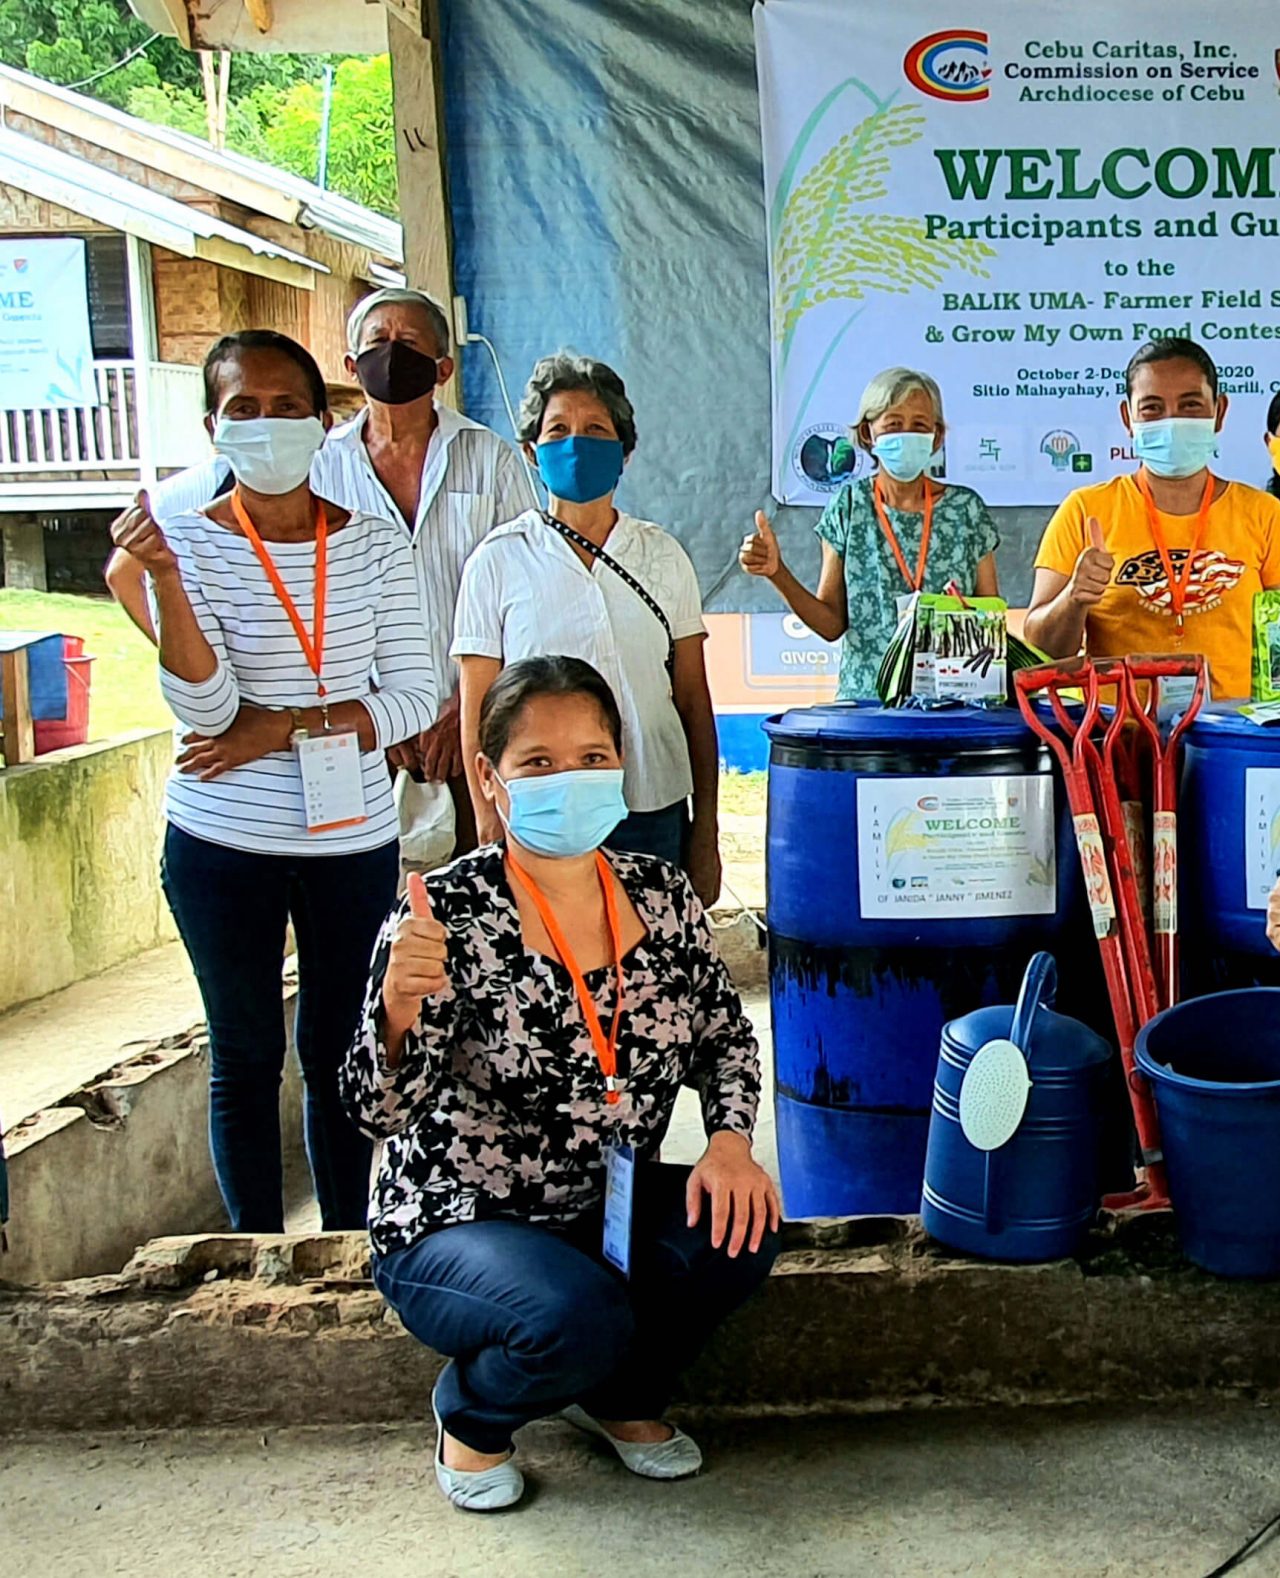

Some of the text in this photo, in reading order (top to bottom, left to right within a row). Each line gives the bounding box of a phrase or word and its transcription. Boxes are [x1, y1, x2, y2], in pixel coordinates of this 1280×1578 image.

[1024, 39, 1238, 61] Cebu Caritas, Inc.
[1004, 60, 1259, 80] Commission on Service
[1018, 83, 1246, 102] Archdiocese of Cebu
[924, 212, 1142, 247] Participants
[1153, 210, 1220, 239] and
[1104, 258, 1176, 278] to the
[942, 291, 1022, 312] BALIK
[1028, 291, 1095, 311] UMA-
[1103, 290, 1194, 311] Farmer
[1200, 288, 1263, 310] Field
[925, 325, 945, 345] &
[951, 323, 1016, 344] Grow
[1024, 323, 1062, 348] My
[1069, 322, 1124, 343] Own
[1132, 321, 1192, 341] Food
[1017, 367, 1080, 381] October
[972, 384, 1011, 398] Sitio
[1015, 383, 1110, 400] Mahayahay,
[1218, 381, 1265, 397] Barili,
[925, 817, 1021, 831] WELCOME
